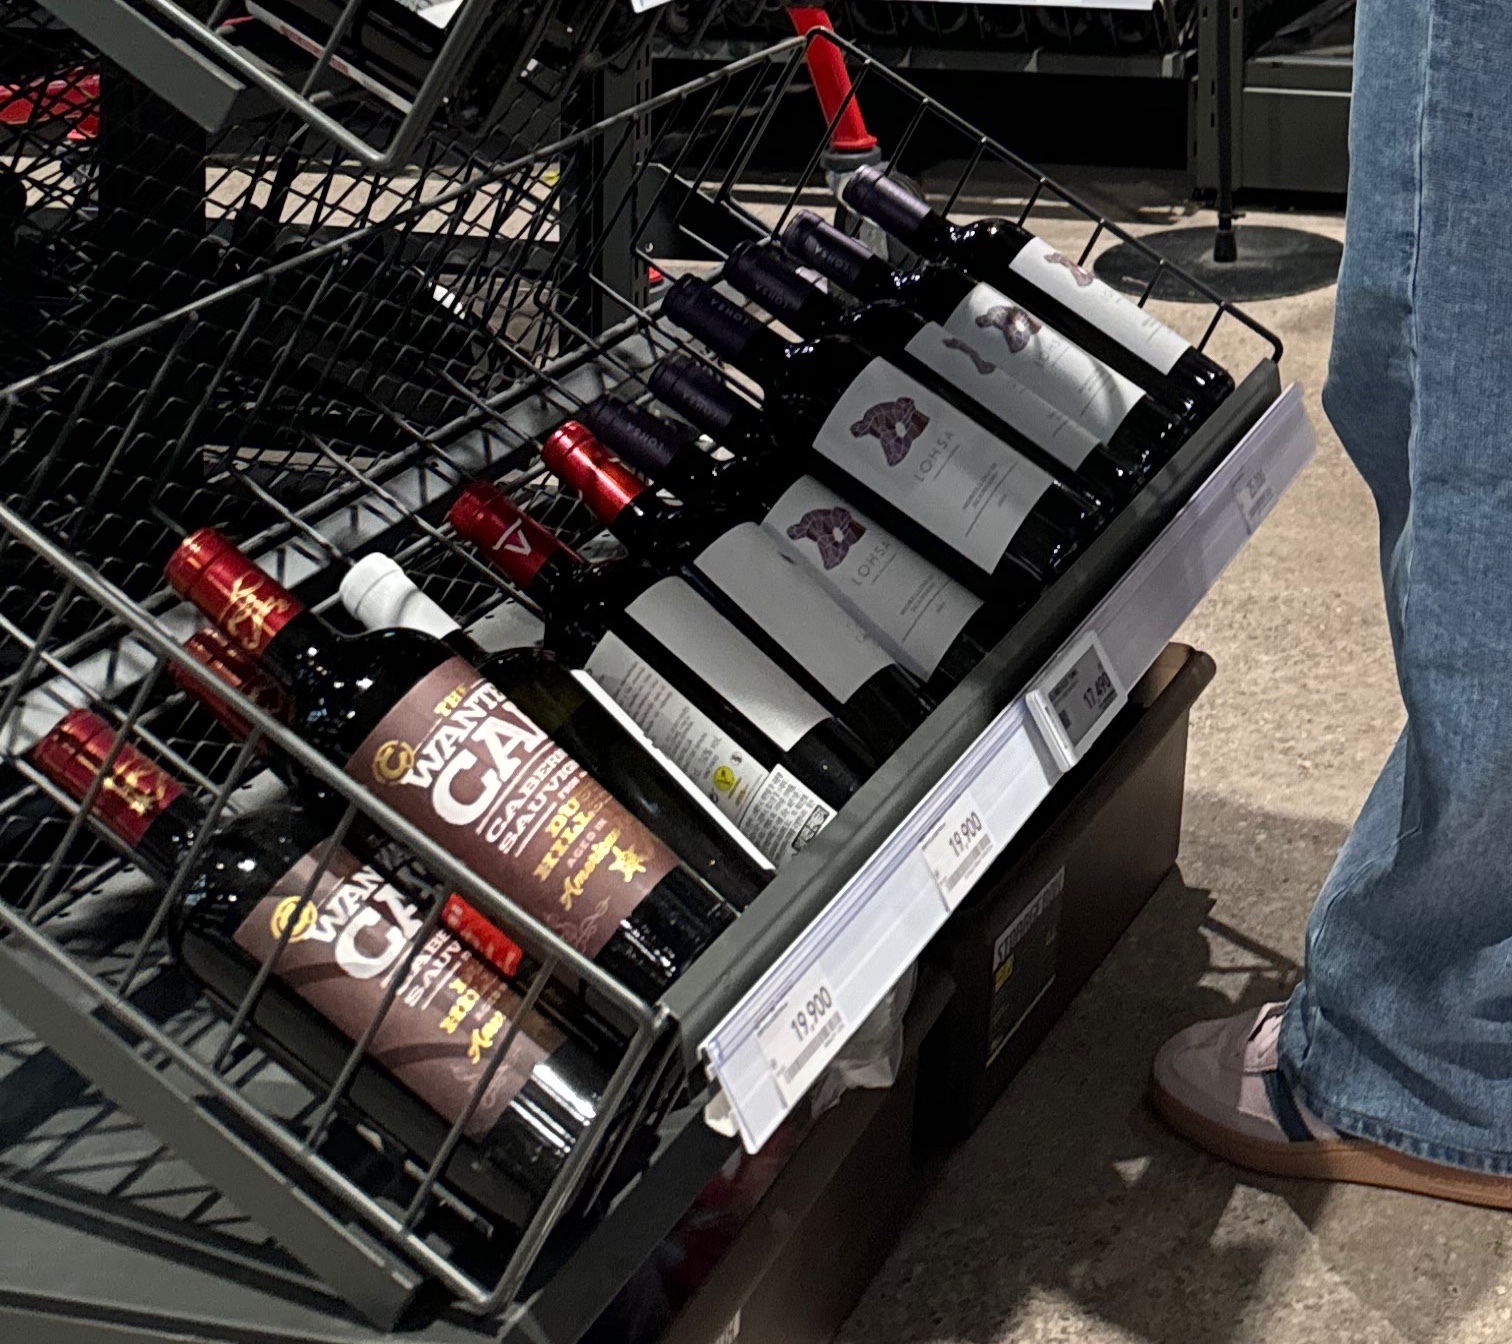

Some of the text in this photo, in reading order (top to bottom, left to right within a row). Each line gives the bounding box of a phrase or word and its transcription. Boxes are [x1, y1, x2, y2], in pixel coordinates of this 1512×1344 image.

[913, 429, 955, 483] LOHSA
[850, 539, 892, 588] LOHSA
[948, 810, 984, 859] 19,900
[790, 985, 834, 1044] 19,900
